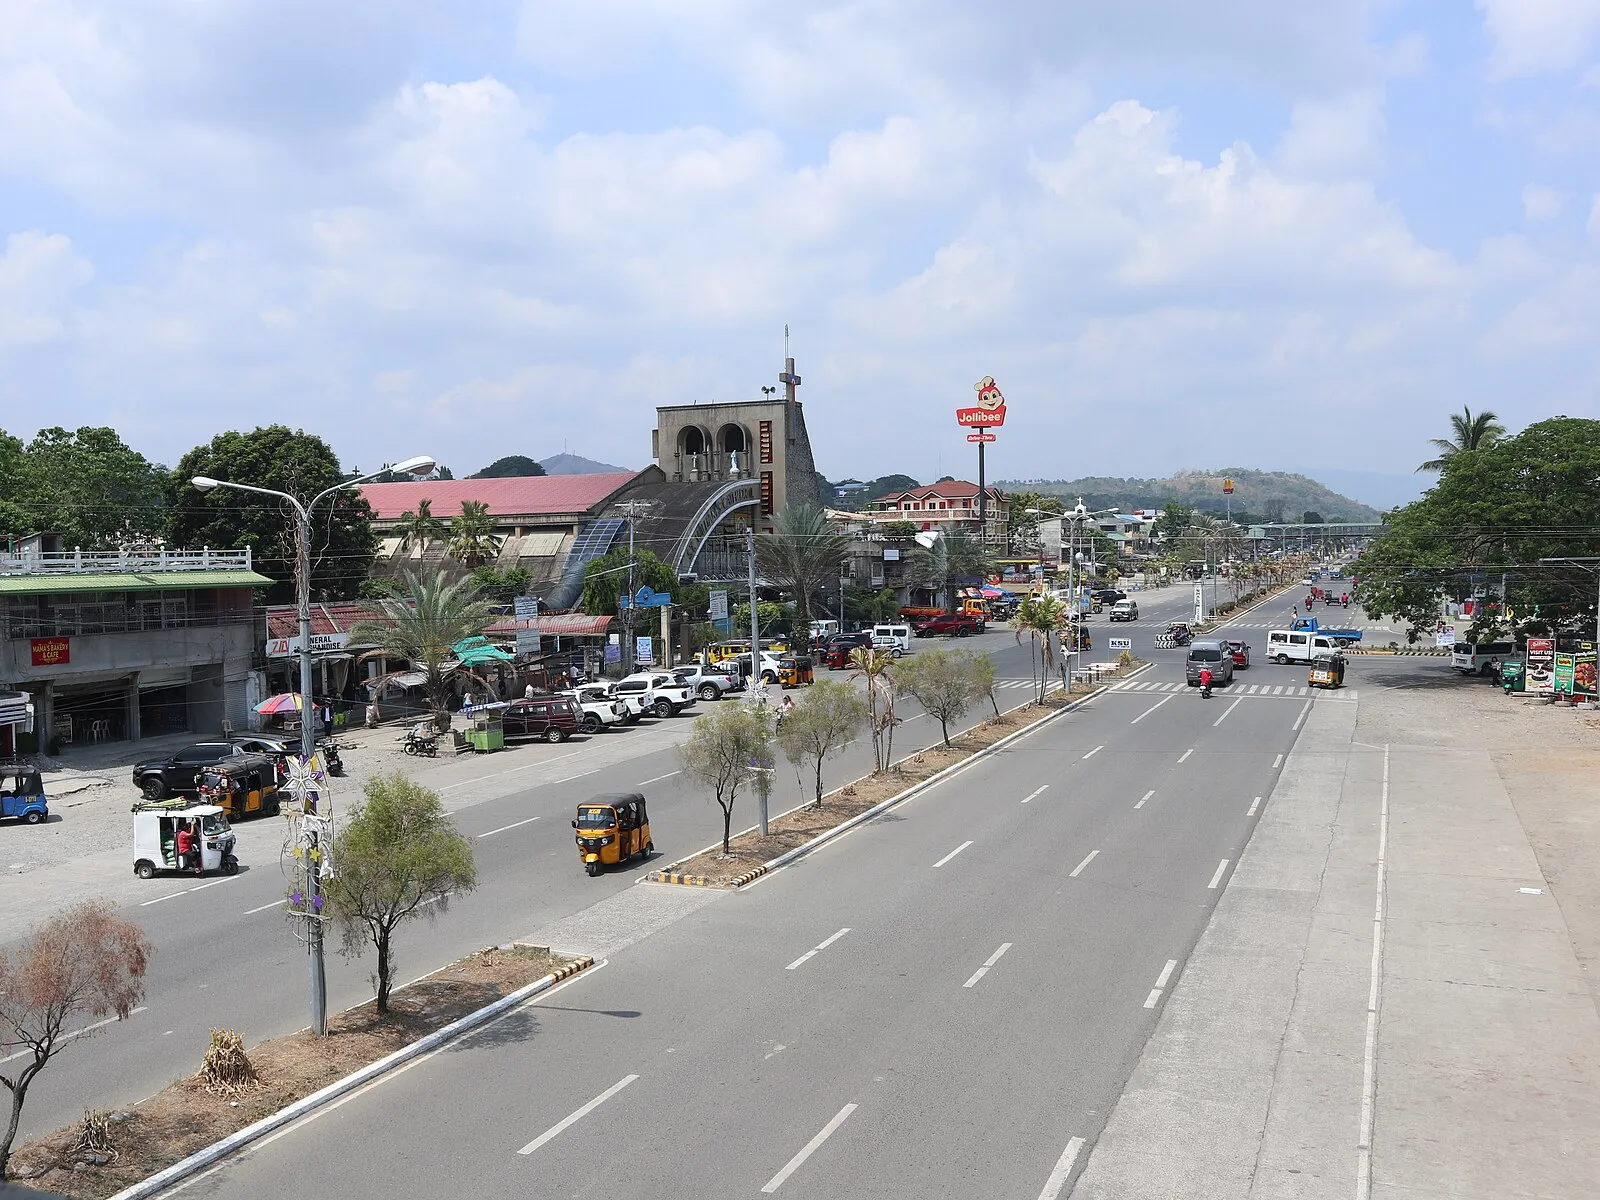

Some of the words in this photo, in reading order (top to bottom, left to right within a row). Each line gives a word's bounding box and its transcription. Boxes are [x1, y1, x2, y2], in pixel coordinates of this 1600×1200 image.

[958, 410, 1001, 422] Jollibee
[310, 636, 332, 644] NERAL
[51, 643, 68, 651] BAKERY
